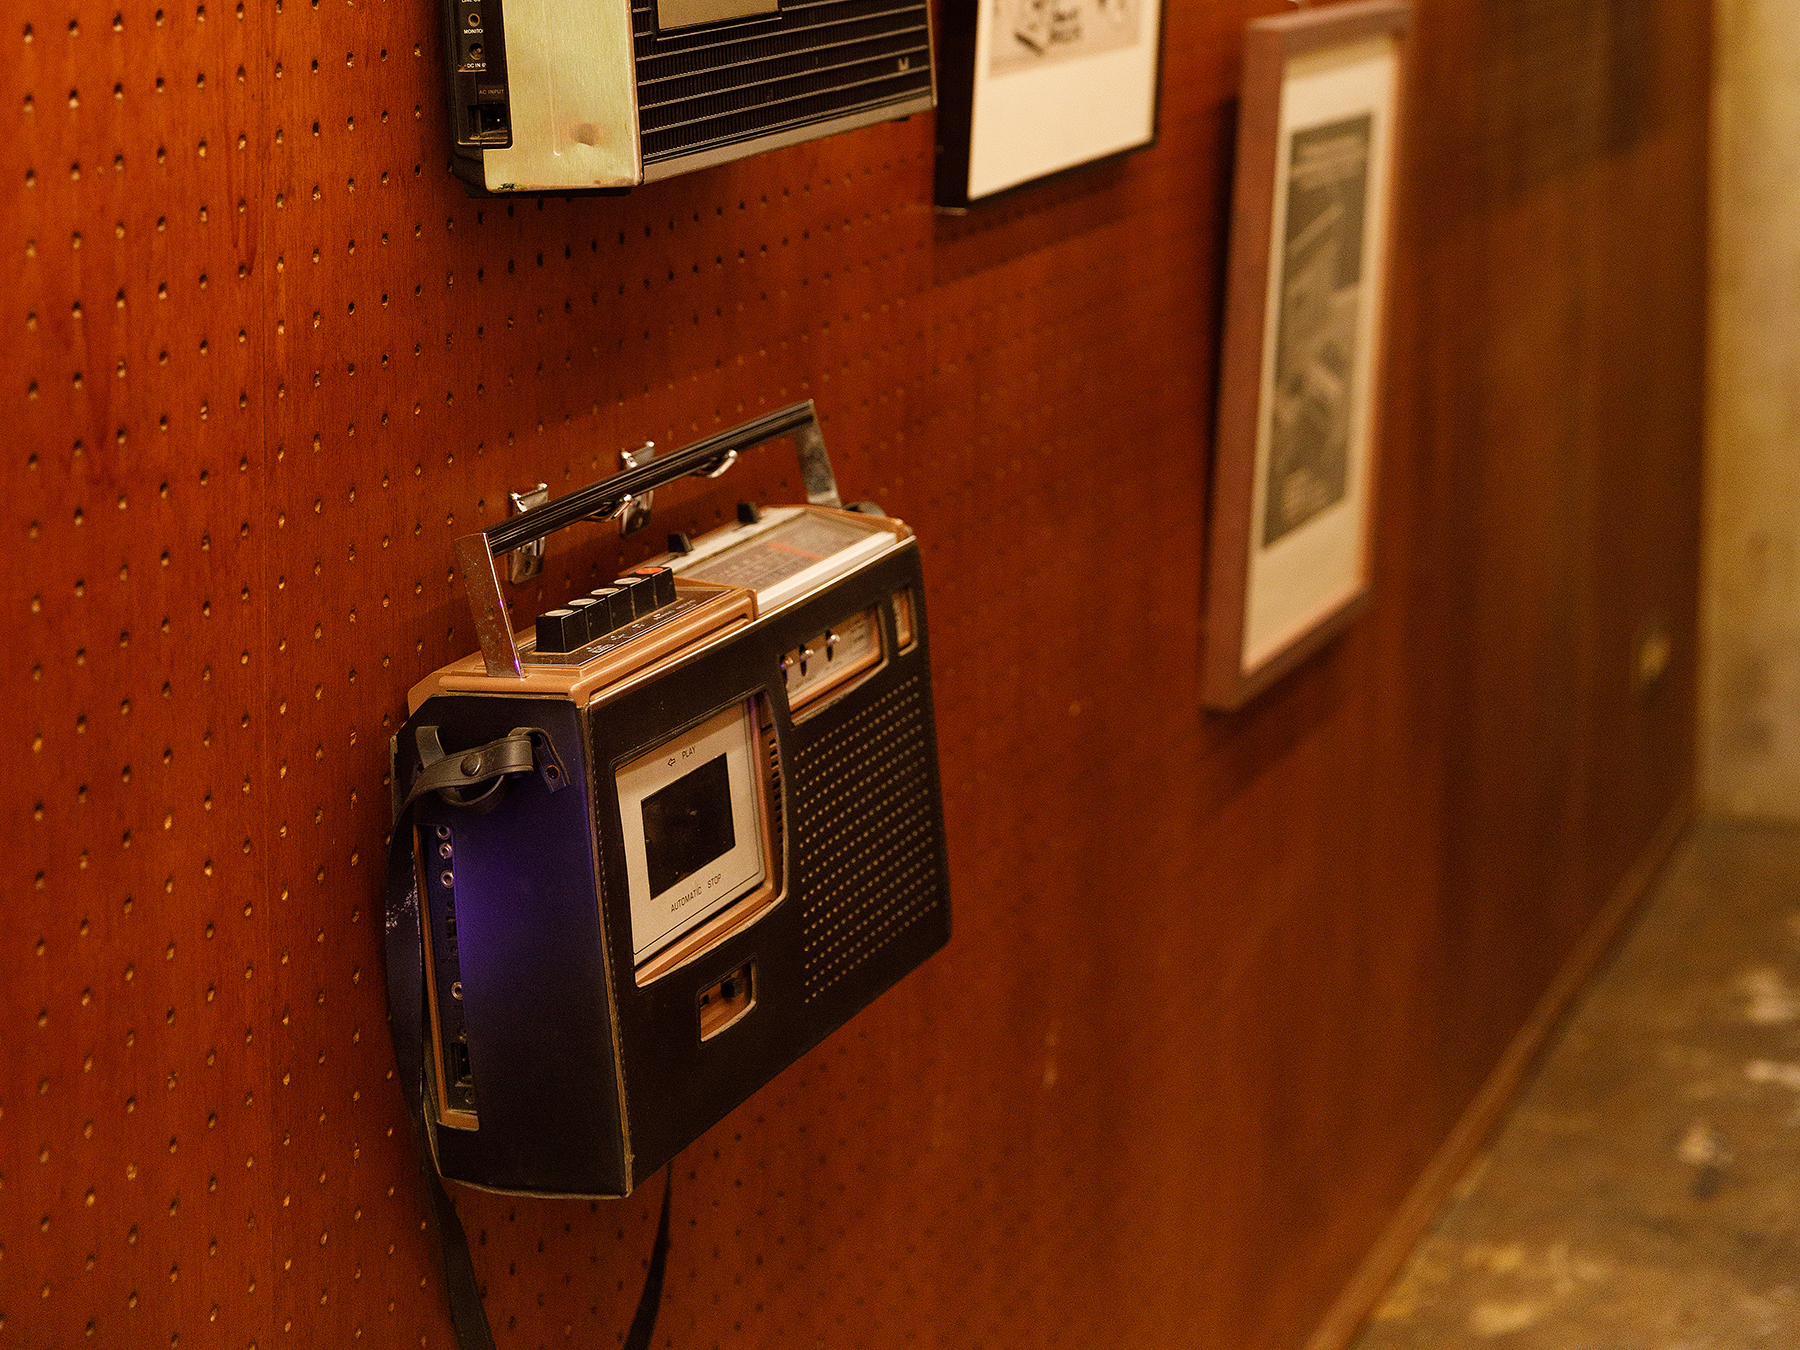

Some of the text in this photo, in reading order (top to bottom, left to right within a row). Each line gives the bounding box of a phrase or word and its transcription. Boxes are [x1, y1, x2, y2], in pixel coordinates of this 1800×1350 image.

[681, 745, 697, 760] PLAY
[669, 872, 722, 913] AUTOMATIC STOP
